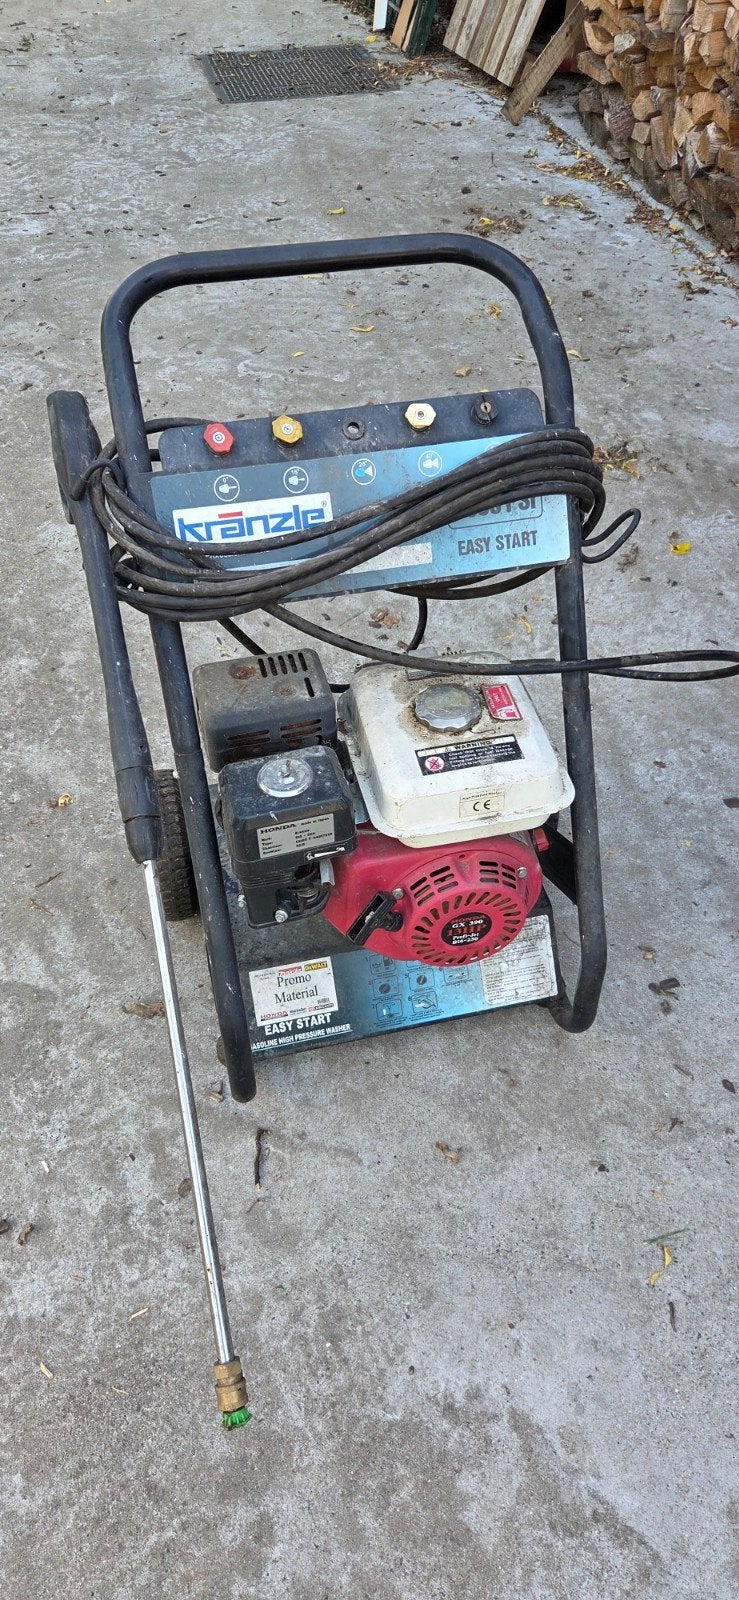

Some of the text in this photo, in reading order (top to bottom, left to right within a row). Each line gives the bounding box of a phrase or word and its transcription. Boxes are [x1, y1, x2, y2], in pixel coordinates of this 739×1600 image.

[458, 530, 538, 556] EASY START
[454, 741, 493, 750] WARNING
[472, 799, 491, 811] CE
[260, 824, 297, 834] HONDA
[452, 915, 486, 923] HONDA
[448, 924, 486, 936] 13HP
[277, 974, 312, 987] Promo
[274, 985, 318, 1004] Material
[264, 1013, 332, 1036] EASY START
[278, 1035, 294, 1044] HIGH
[295, 1029, 325, 1041] PRESSURE
[326, 1024, 350, 1034] WASHER
